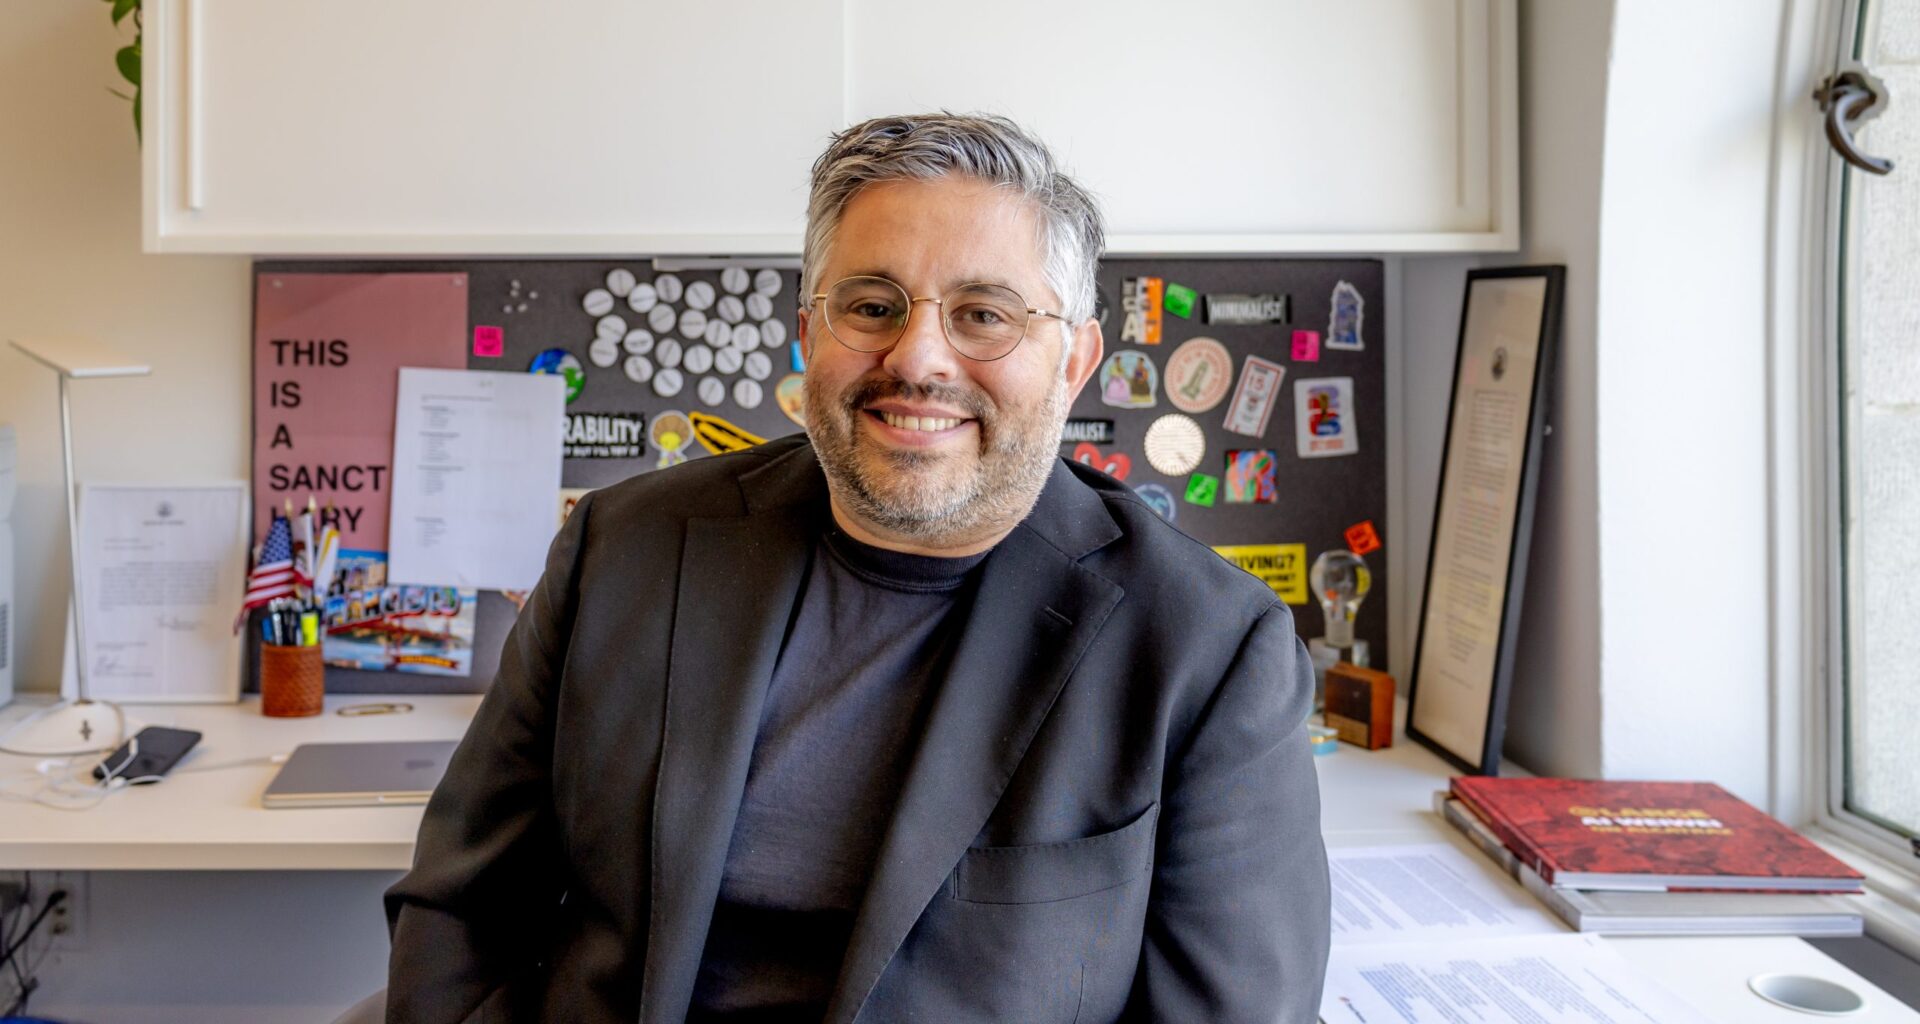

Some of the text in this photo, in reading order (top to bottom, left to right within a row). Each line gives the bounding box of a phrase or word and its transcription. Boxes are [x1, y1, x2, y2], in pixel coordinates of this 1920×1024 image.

[270, 340, 349, 366] THIS
[271, 382, 302, 408] IS
[270, 424, 293, 449] A
[269, 465, 387, 492] SANCT
